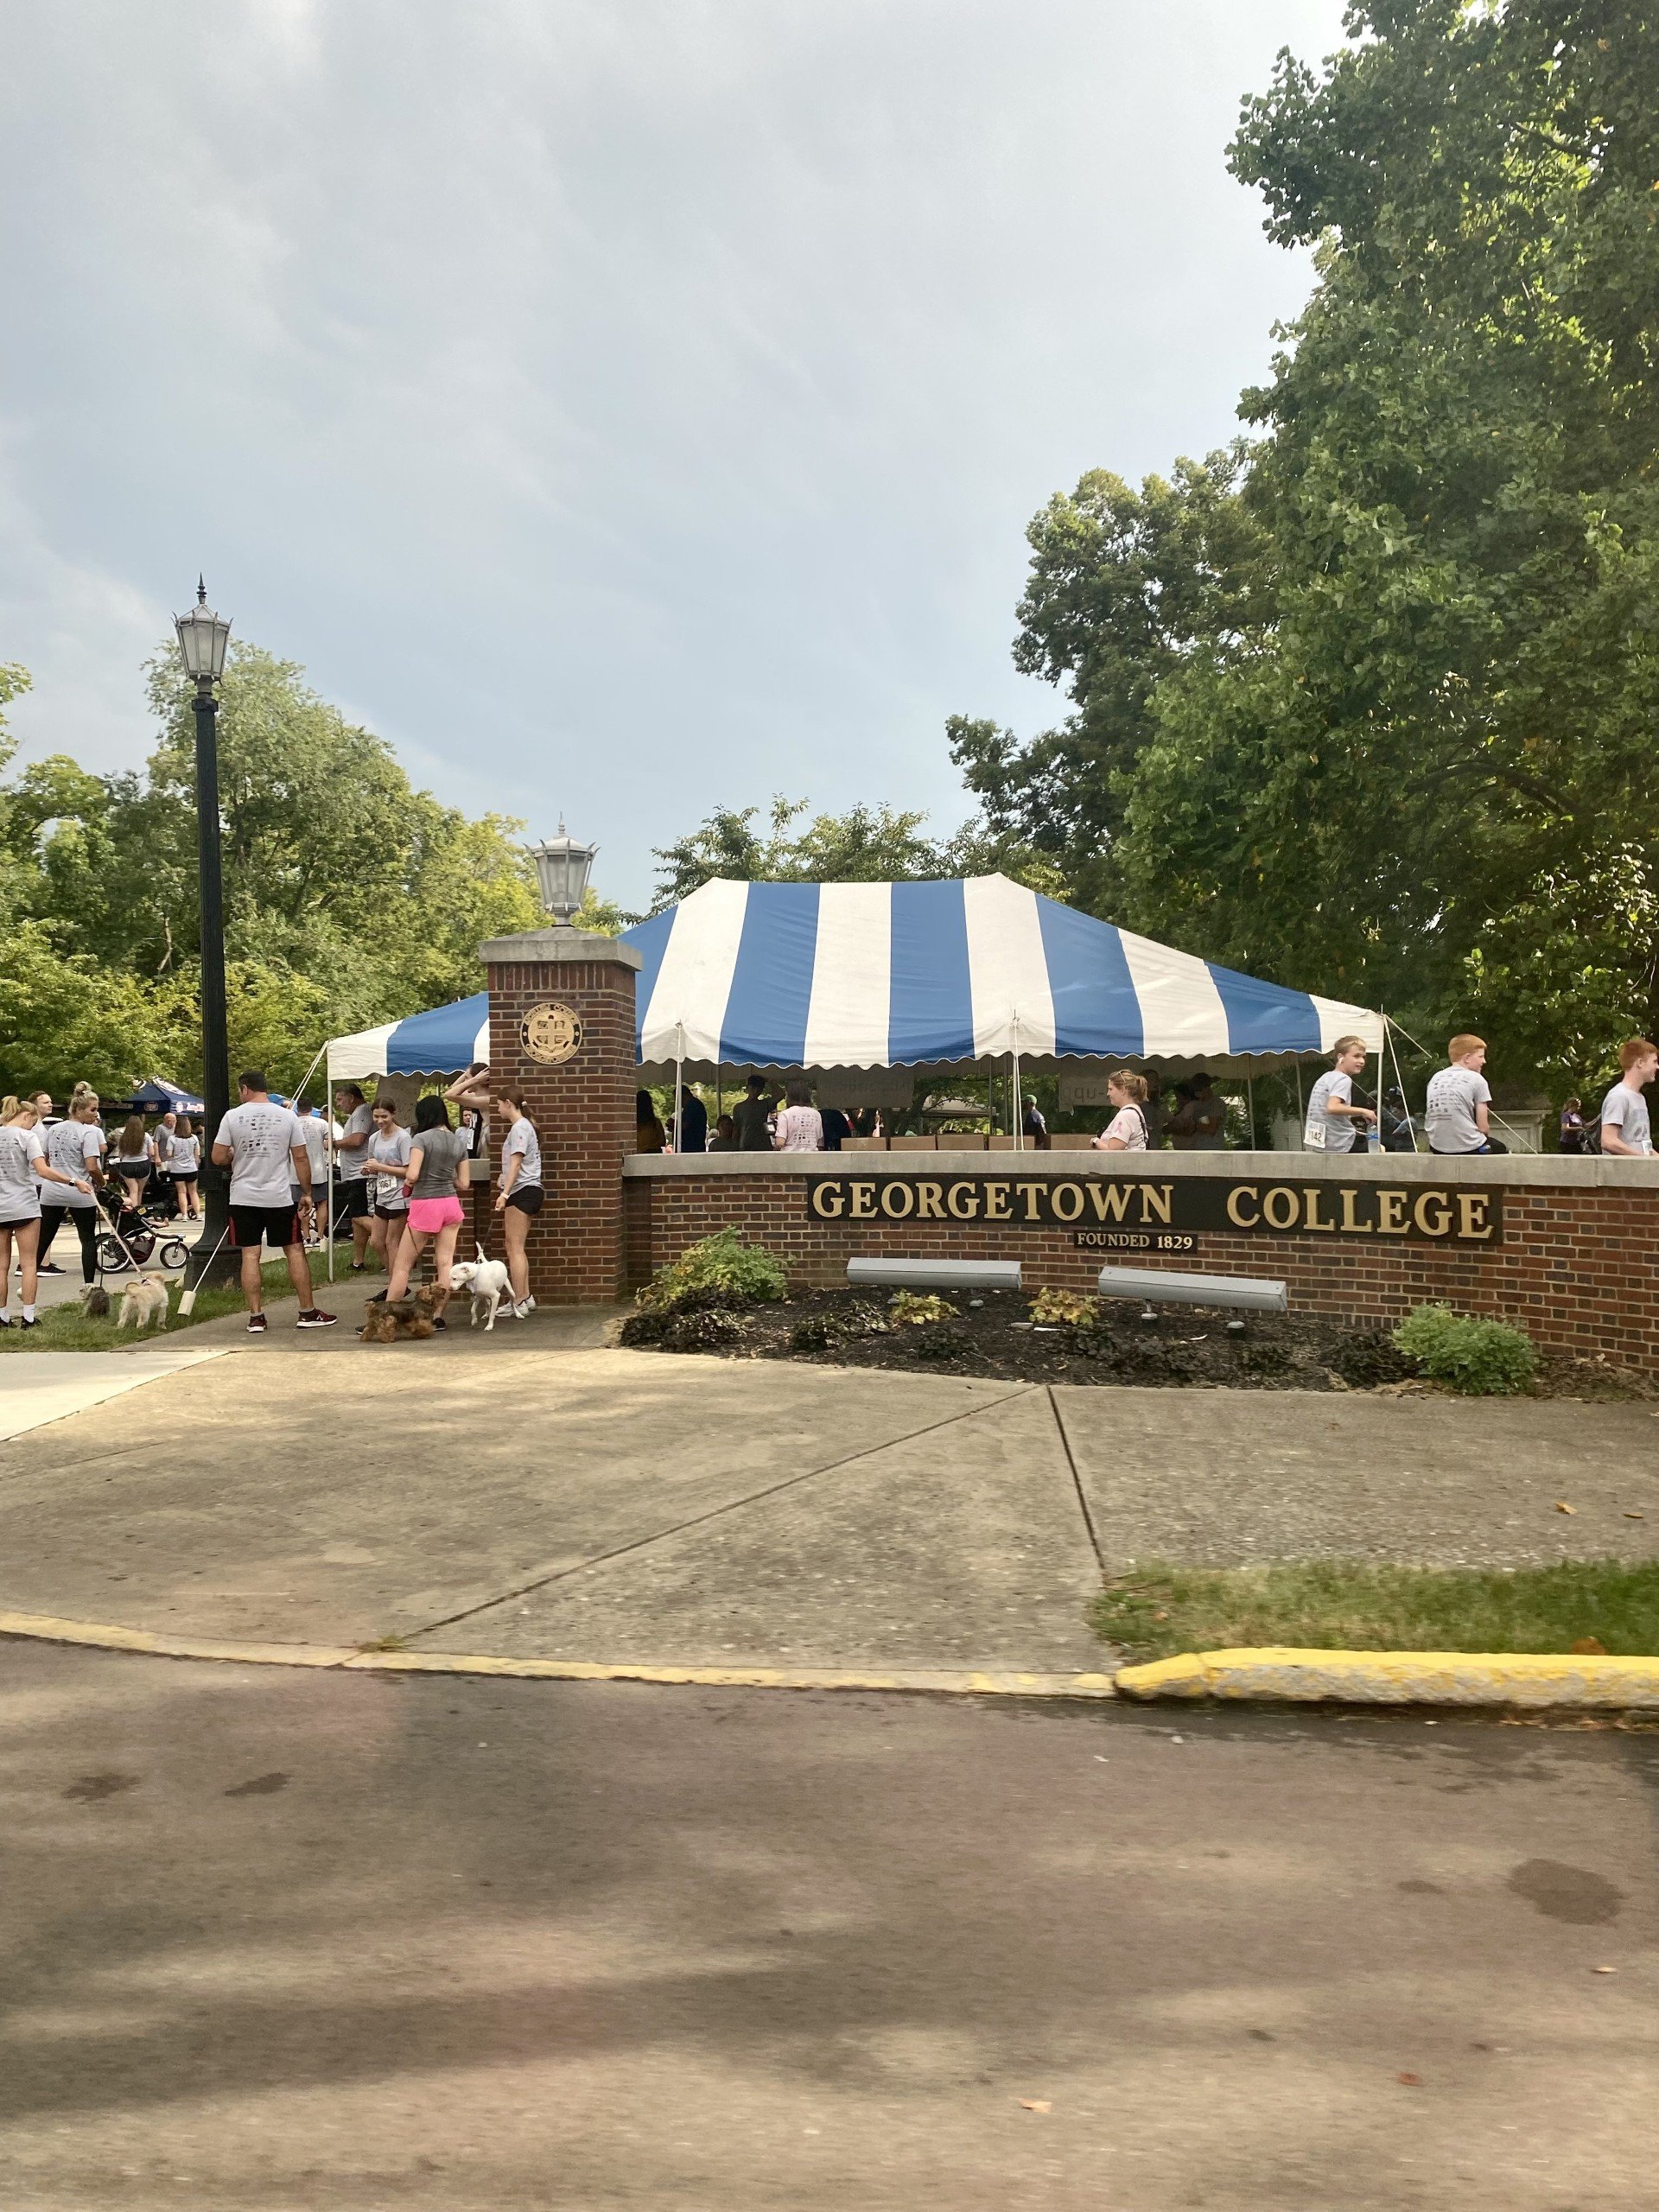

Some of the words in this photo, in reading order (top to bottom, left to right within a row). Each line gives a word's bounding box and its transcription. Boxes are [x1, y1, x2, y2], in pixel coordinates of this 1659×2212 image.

[812, 1181, 1174, 1224] GEORGETOWN
[1226, 1185, 1494, 1239] COLLEGE
[1077, 1232, 1151, 1248] FOUNDED
[1157, 1236, 1193, 1249] 1829
